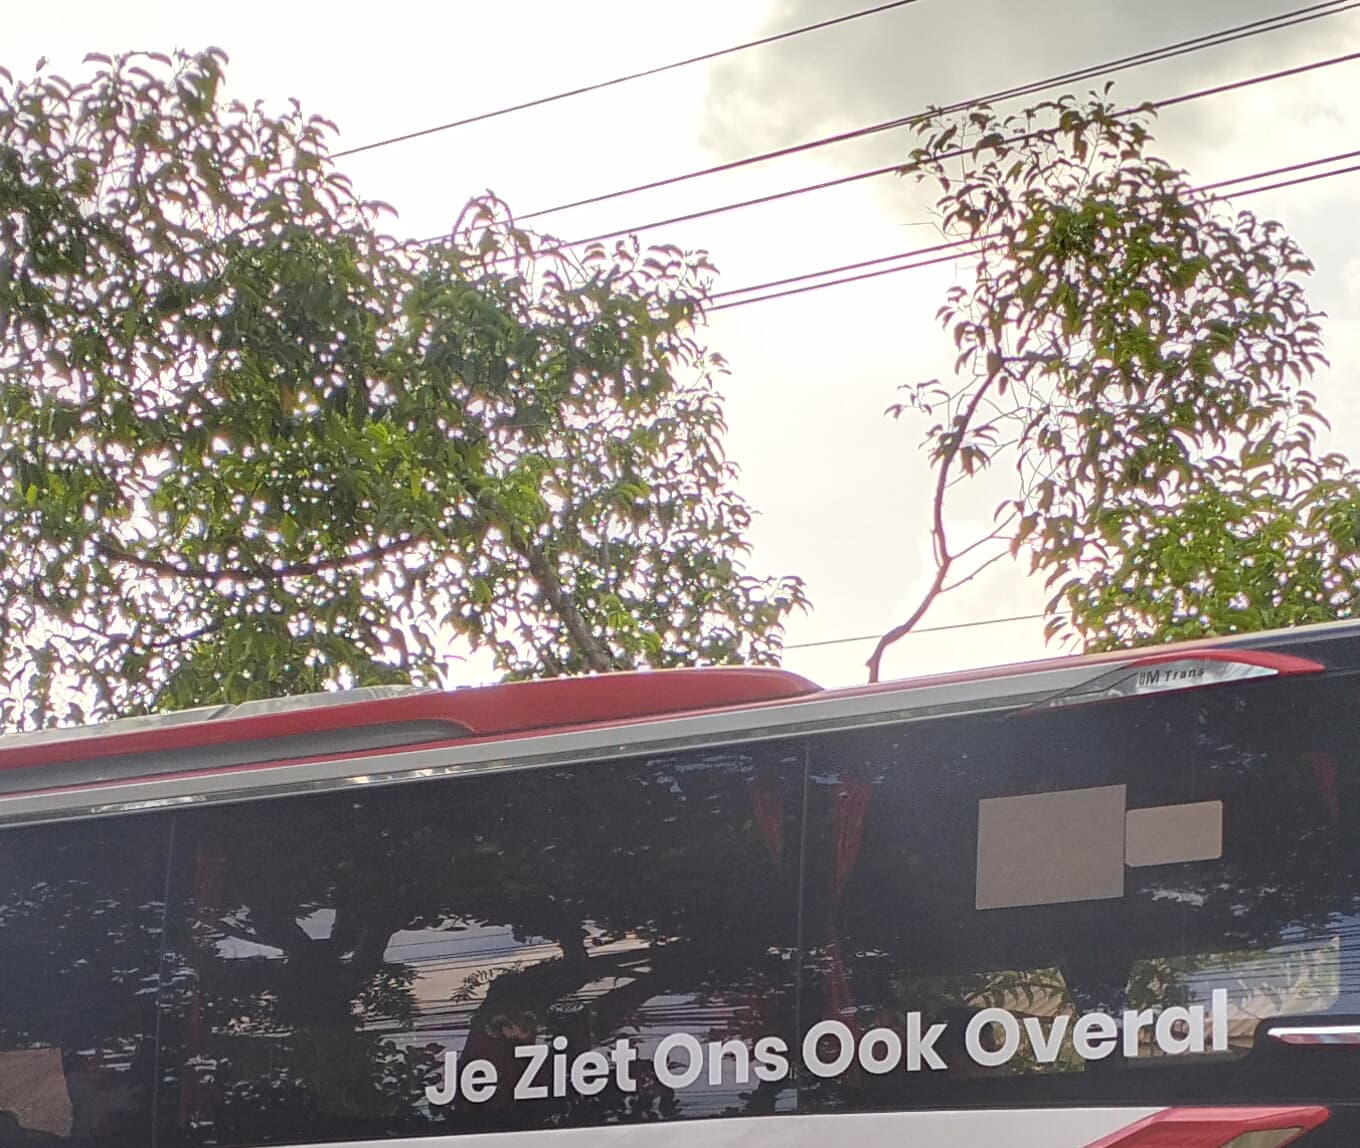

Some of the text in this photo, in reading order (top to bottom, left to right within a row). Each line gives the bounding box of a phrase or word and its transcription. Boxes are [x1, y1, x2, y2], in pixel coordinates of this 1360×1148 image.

[425, 988, 1228, 1106] Je Ziet Ons Ook Overal
